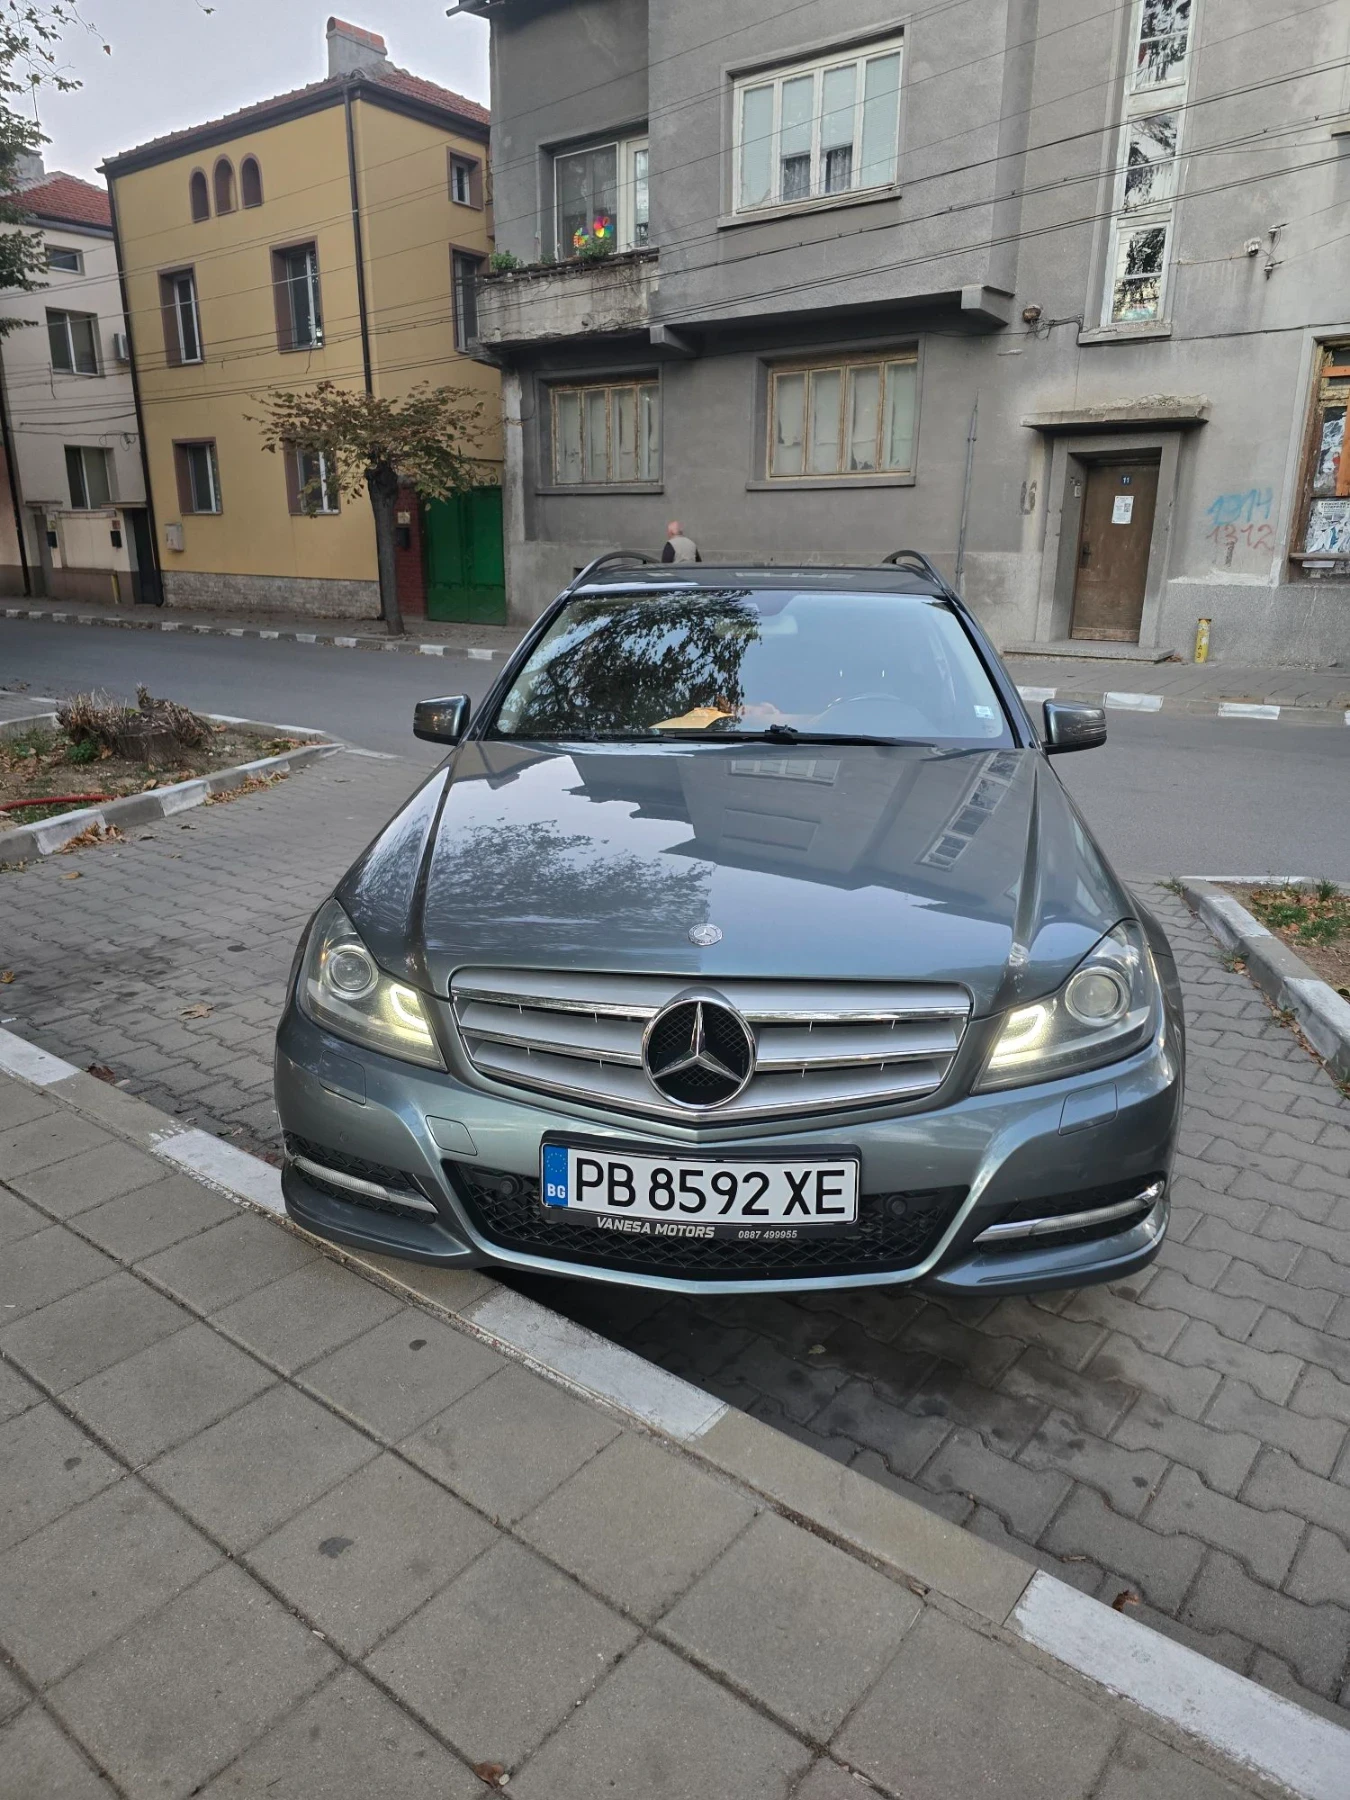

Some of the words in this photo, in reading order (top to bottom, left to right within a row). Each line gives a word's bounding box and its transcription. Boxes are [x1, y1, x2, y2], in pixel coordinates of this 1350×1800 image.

[1205, 523, 1275, 552] 1312
[547, 1183, 566, 1199] BG
[576, 1157, 636, 1208] PB
[648, 1167, 770, 1215] 8592
[782, 1169, 845, 1216] XE
[596, 1216, 651, 1235] VANESA
[654, 1223, 716, 1239] MOTORS
[738, 1230, 761, 1239] 0887
[763, 1230, 798, 1239] 499955
